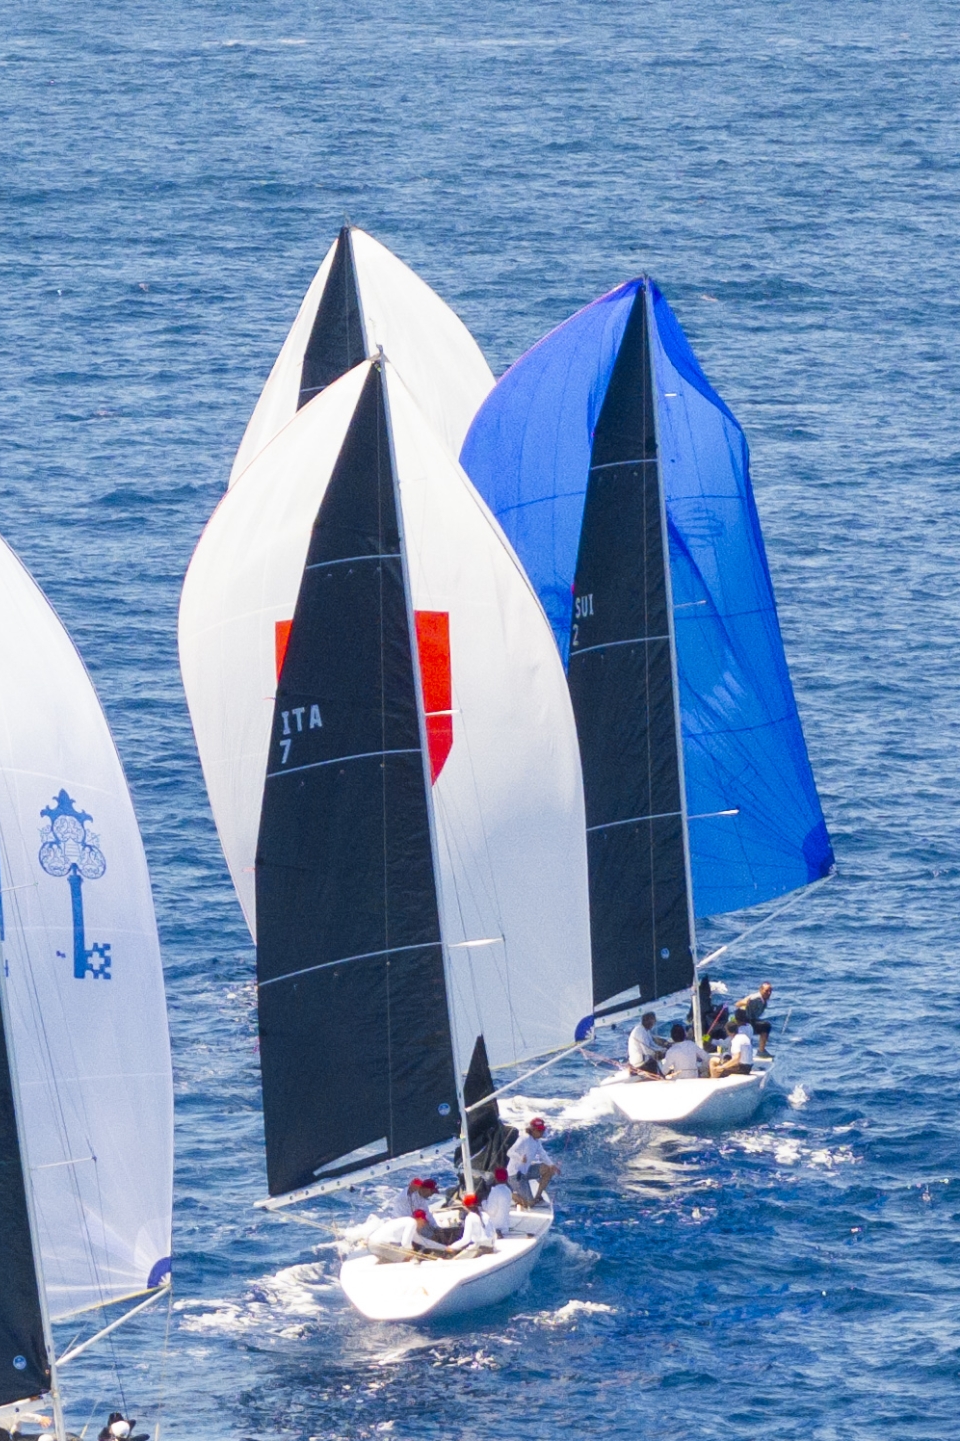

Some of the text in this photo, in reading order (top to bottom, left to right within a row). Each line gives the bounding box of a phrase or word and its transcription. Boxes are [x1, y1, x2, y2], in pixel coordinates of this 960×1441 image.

[575, 594, 594, 619] SUI
[572, 624, 579, 646] 2
[281, 704, 323, 735] ITA
[280, 739, 291, 764] 7
